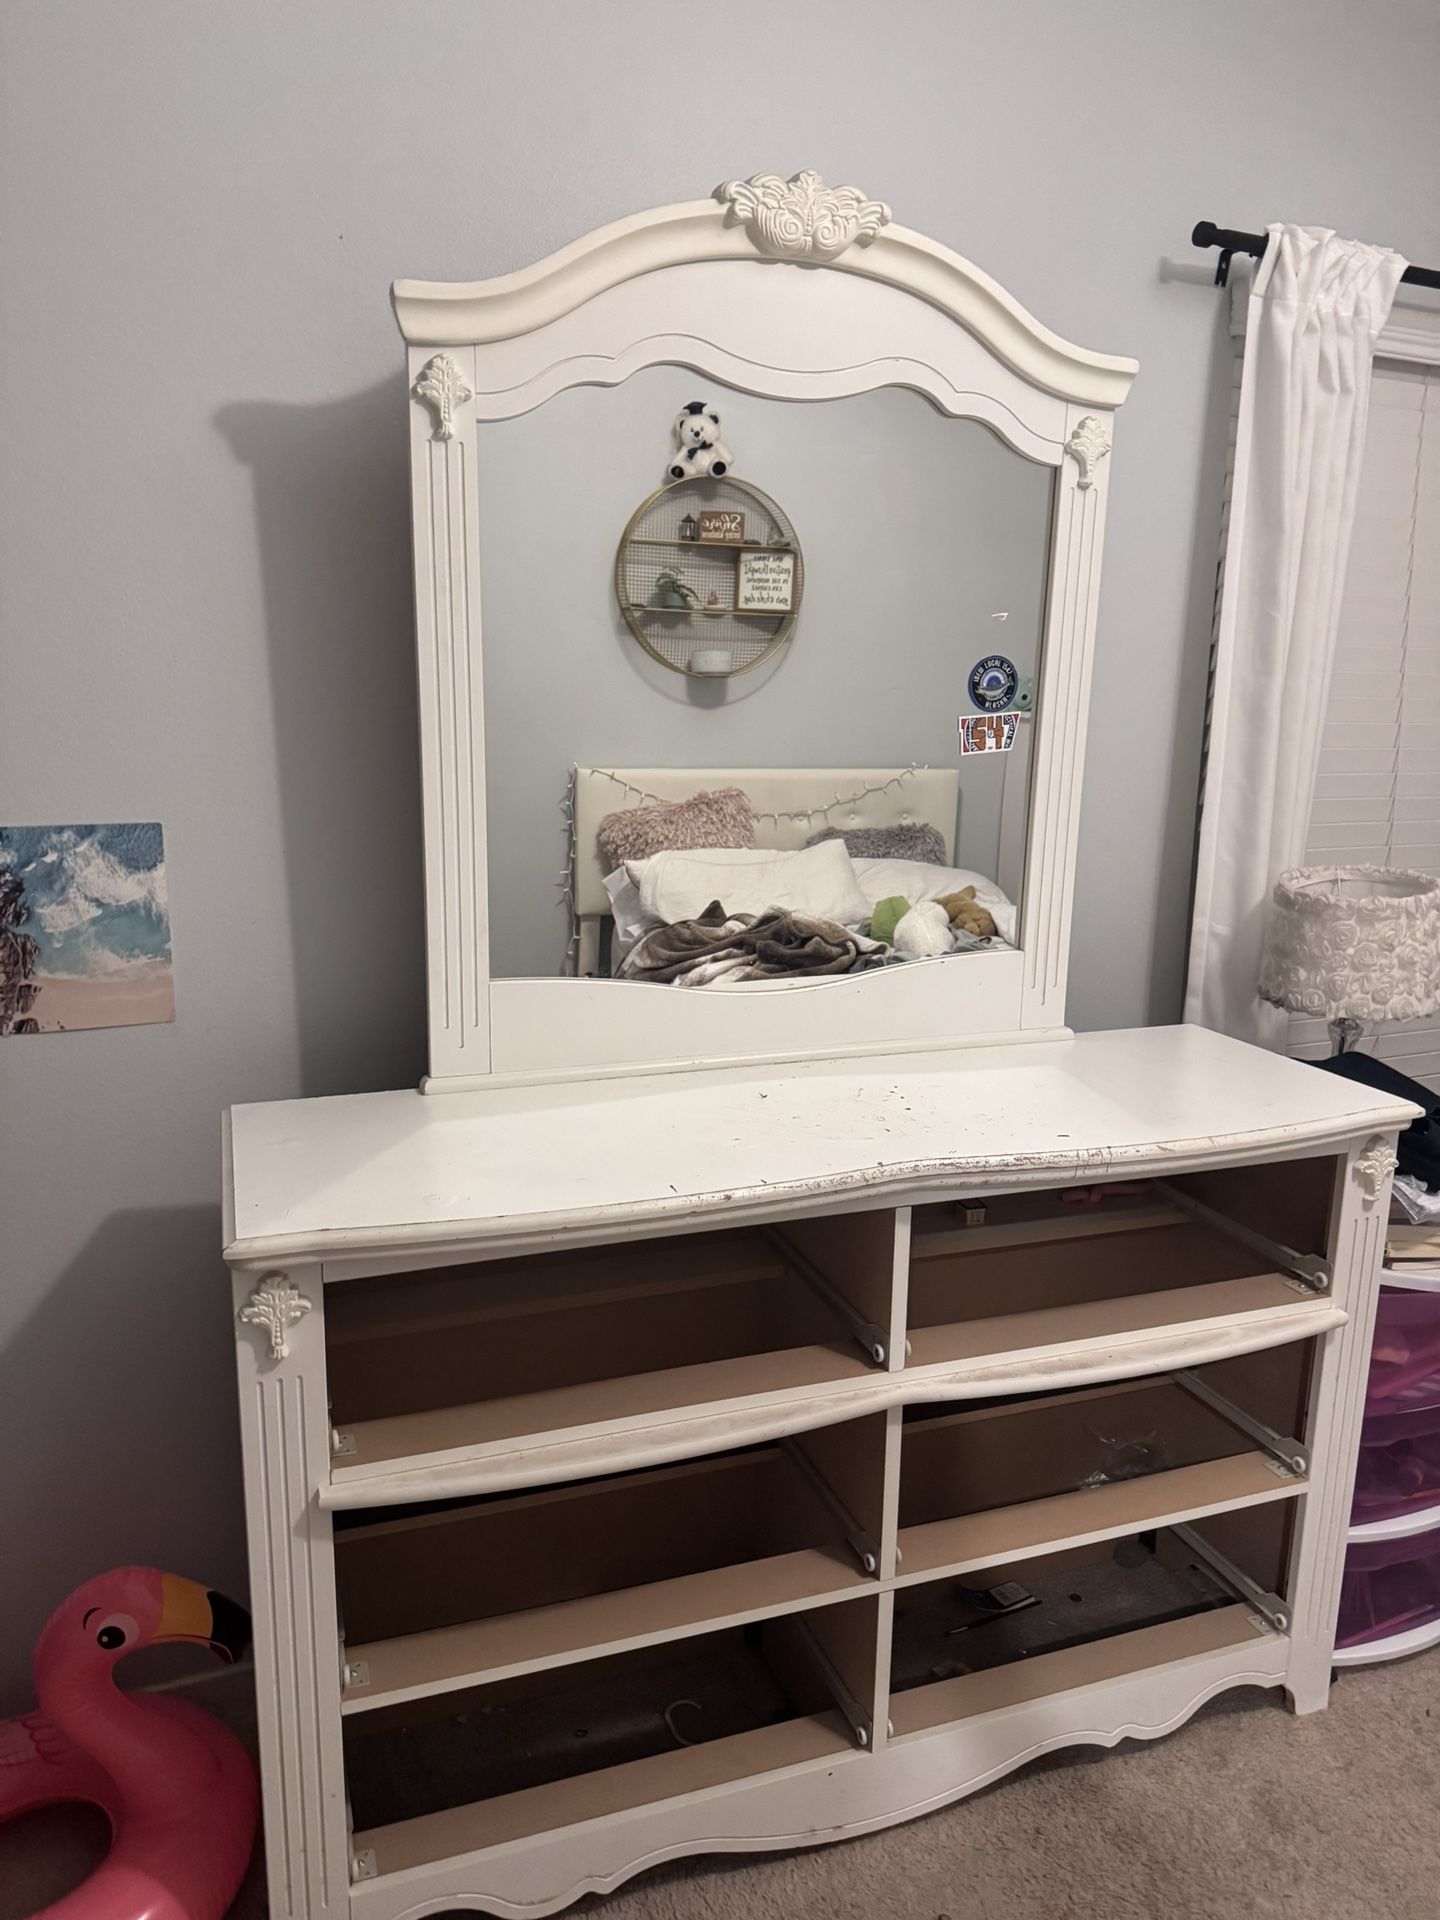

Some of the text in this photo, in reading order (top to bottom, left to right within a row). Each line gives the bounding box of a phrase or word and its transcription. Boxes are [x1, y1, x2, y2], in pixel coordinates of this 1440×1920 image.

[983, 659, 1001, 669] LOCAL
[1002, 662, 1013, 675] 1547
[984, 696, 1009, 709] ALASKA
[960, 712, 1021, 755] 1547
